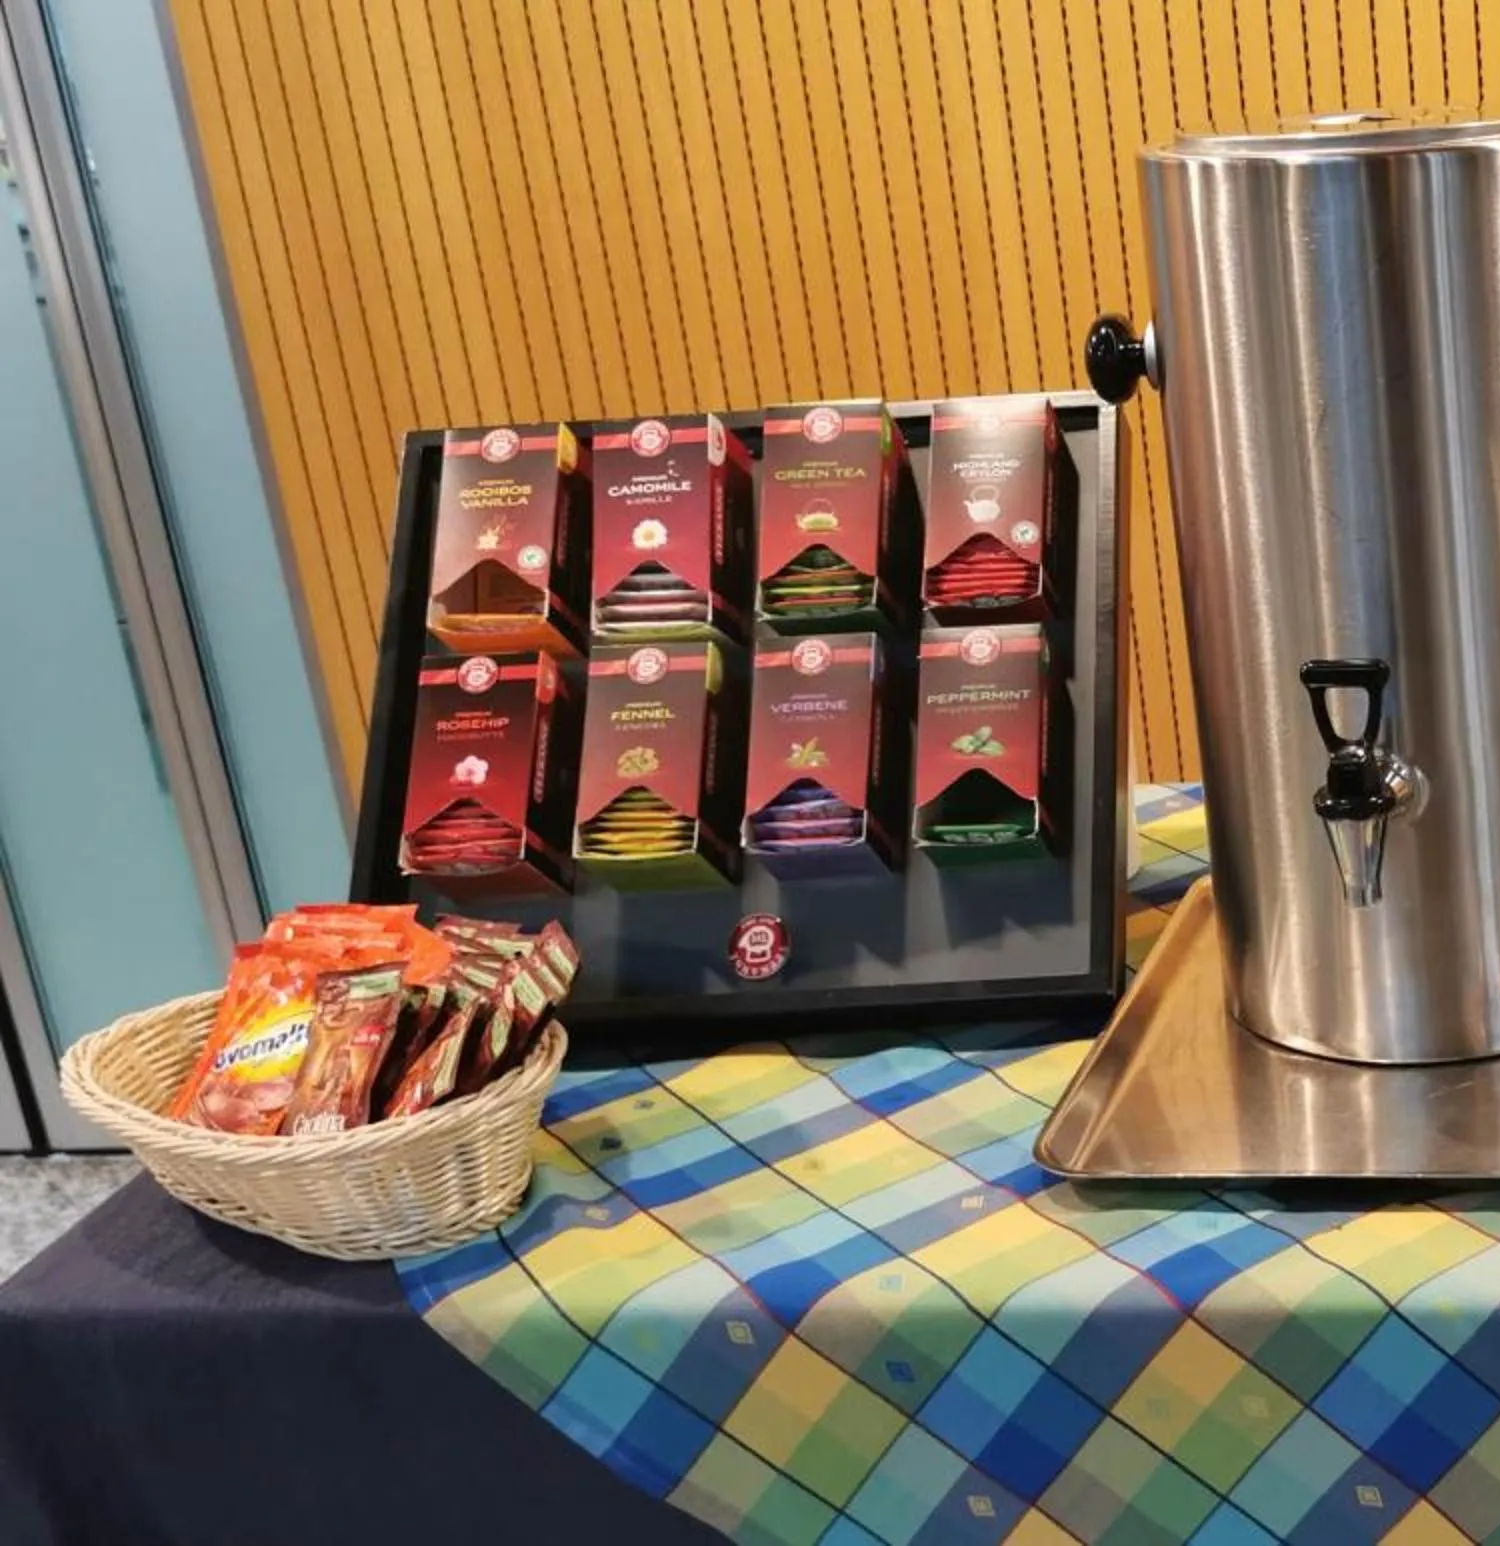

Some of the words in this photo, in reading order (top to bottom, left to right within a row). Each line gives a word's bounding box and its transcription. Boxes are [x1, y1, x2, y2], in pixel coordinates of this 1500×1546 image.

[774, 468, 829, 481] GREEN
[834, 467, 867, 479] TEA
[607, 480, 693, 497] CAMOMILE
[926, 689, 1033, 705] PEPPERMINT
[770, 699, 848, 713] VERBENE
[610, 707, 676, 720] FENNEL
[436, 717, 510, 732] ROSEHIP
